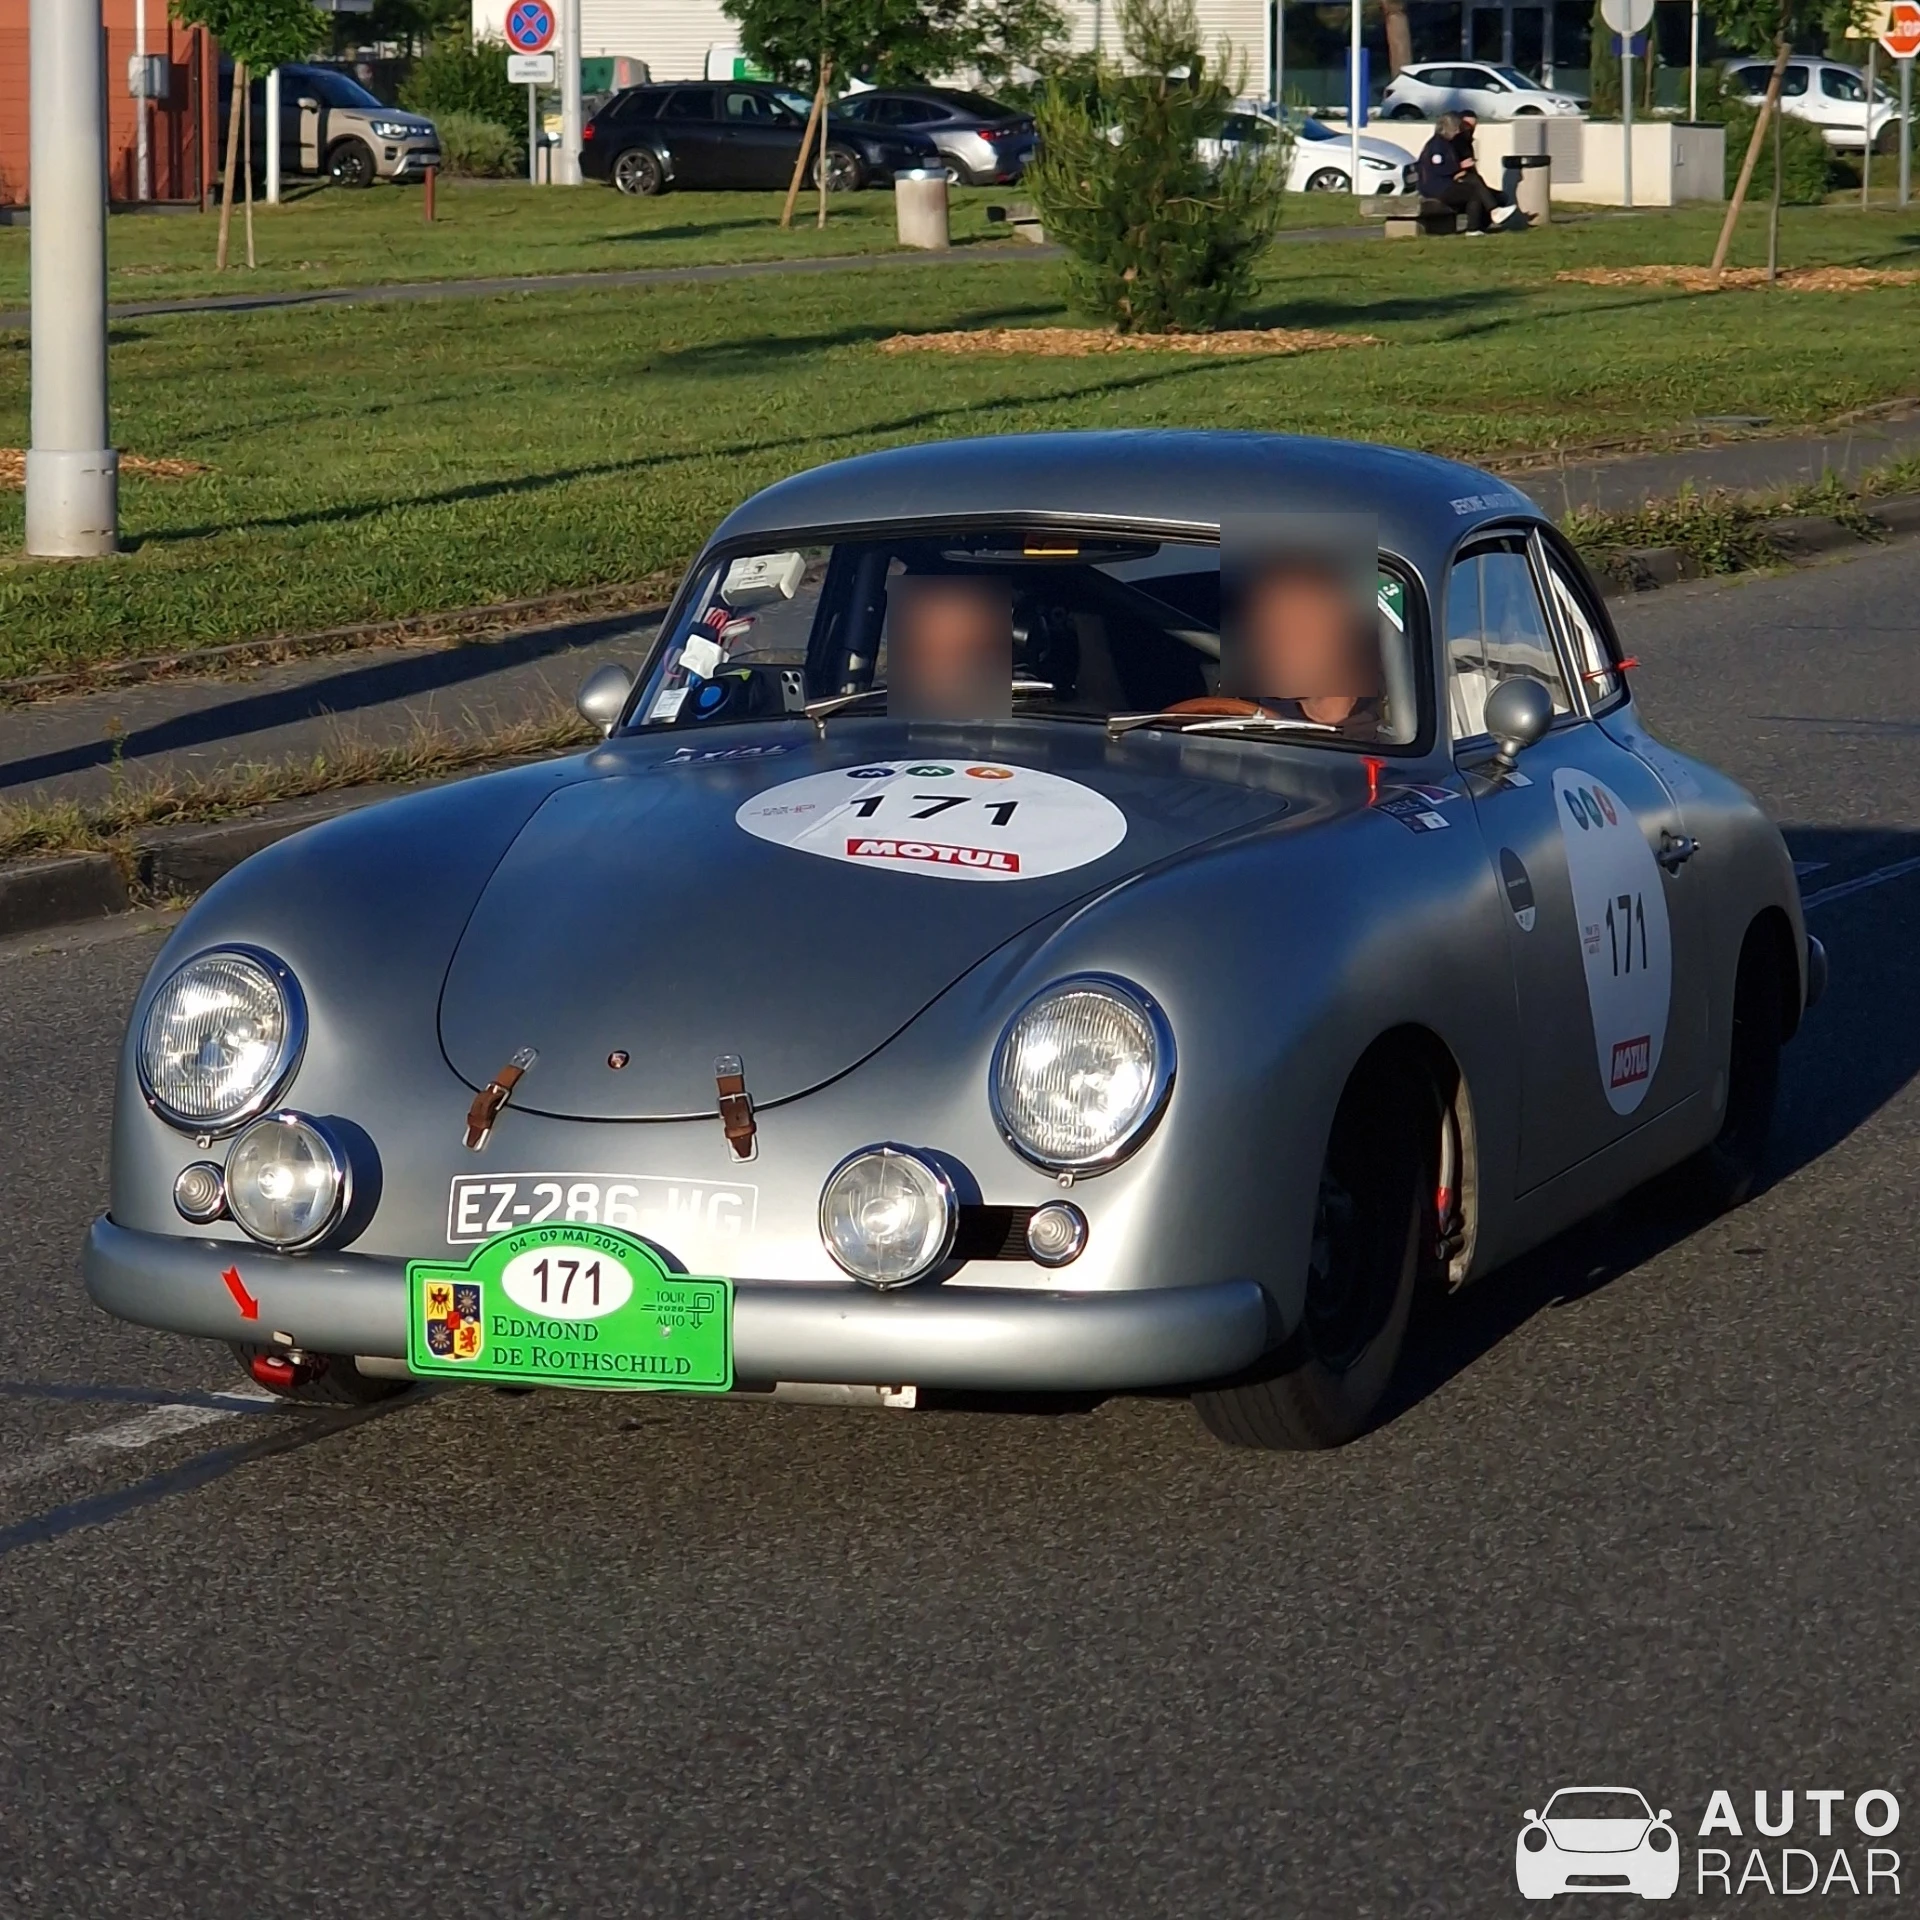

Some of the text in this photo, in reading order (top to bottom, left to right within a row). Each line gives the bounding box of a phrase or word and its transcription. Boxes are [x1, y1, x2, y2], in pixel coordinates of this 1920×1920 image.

[1888, 20, 1920, 37] TOP
[850, 794, 1021, 826] 171
[855, 841, 1013, 870] MOTUL
[1605, 892, 1648, 977] 171
[1613, 1042, 1650, 1082] MOTUL
[510, 1237, 528, 1253] 04
[539, 1230, 557, 1243] 09
[562, 1230, 590, 1244] MAI
[593, 1235, 629, 1259] 2026
[533, 1259, 602, 1306] 171
[656, 1290, 685, 1304] TOUR
[492, 1315, 599, 1342] EDMOND
[655, 1315, 685, 1328] AUTO
[493, 1347, 691, 1375] DE ROTHSCHILD
